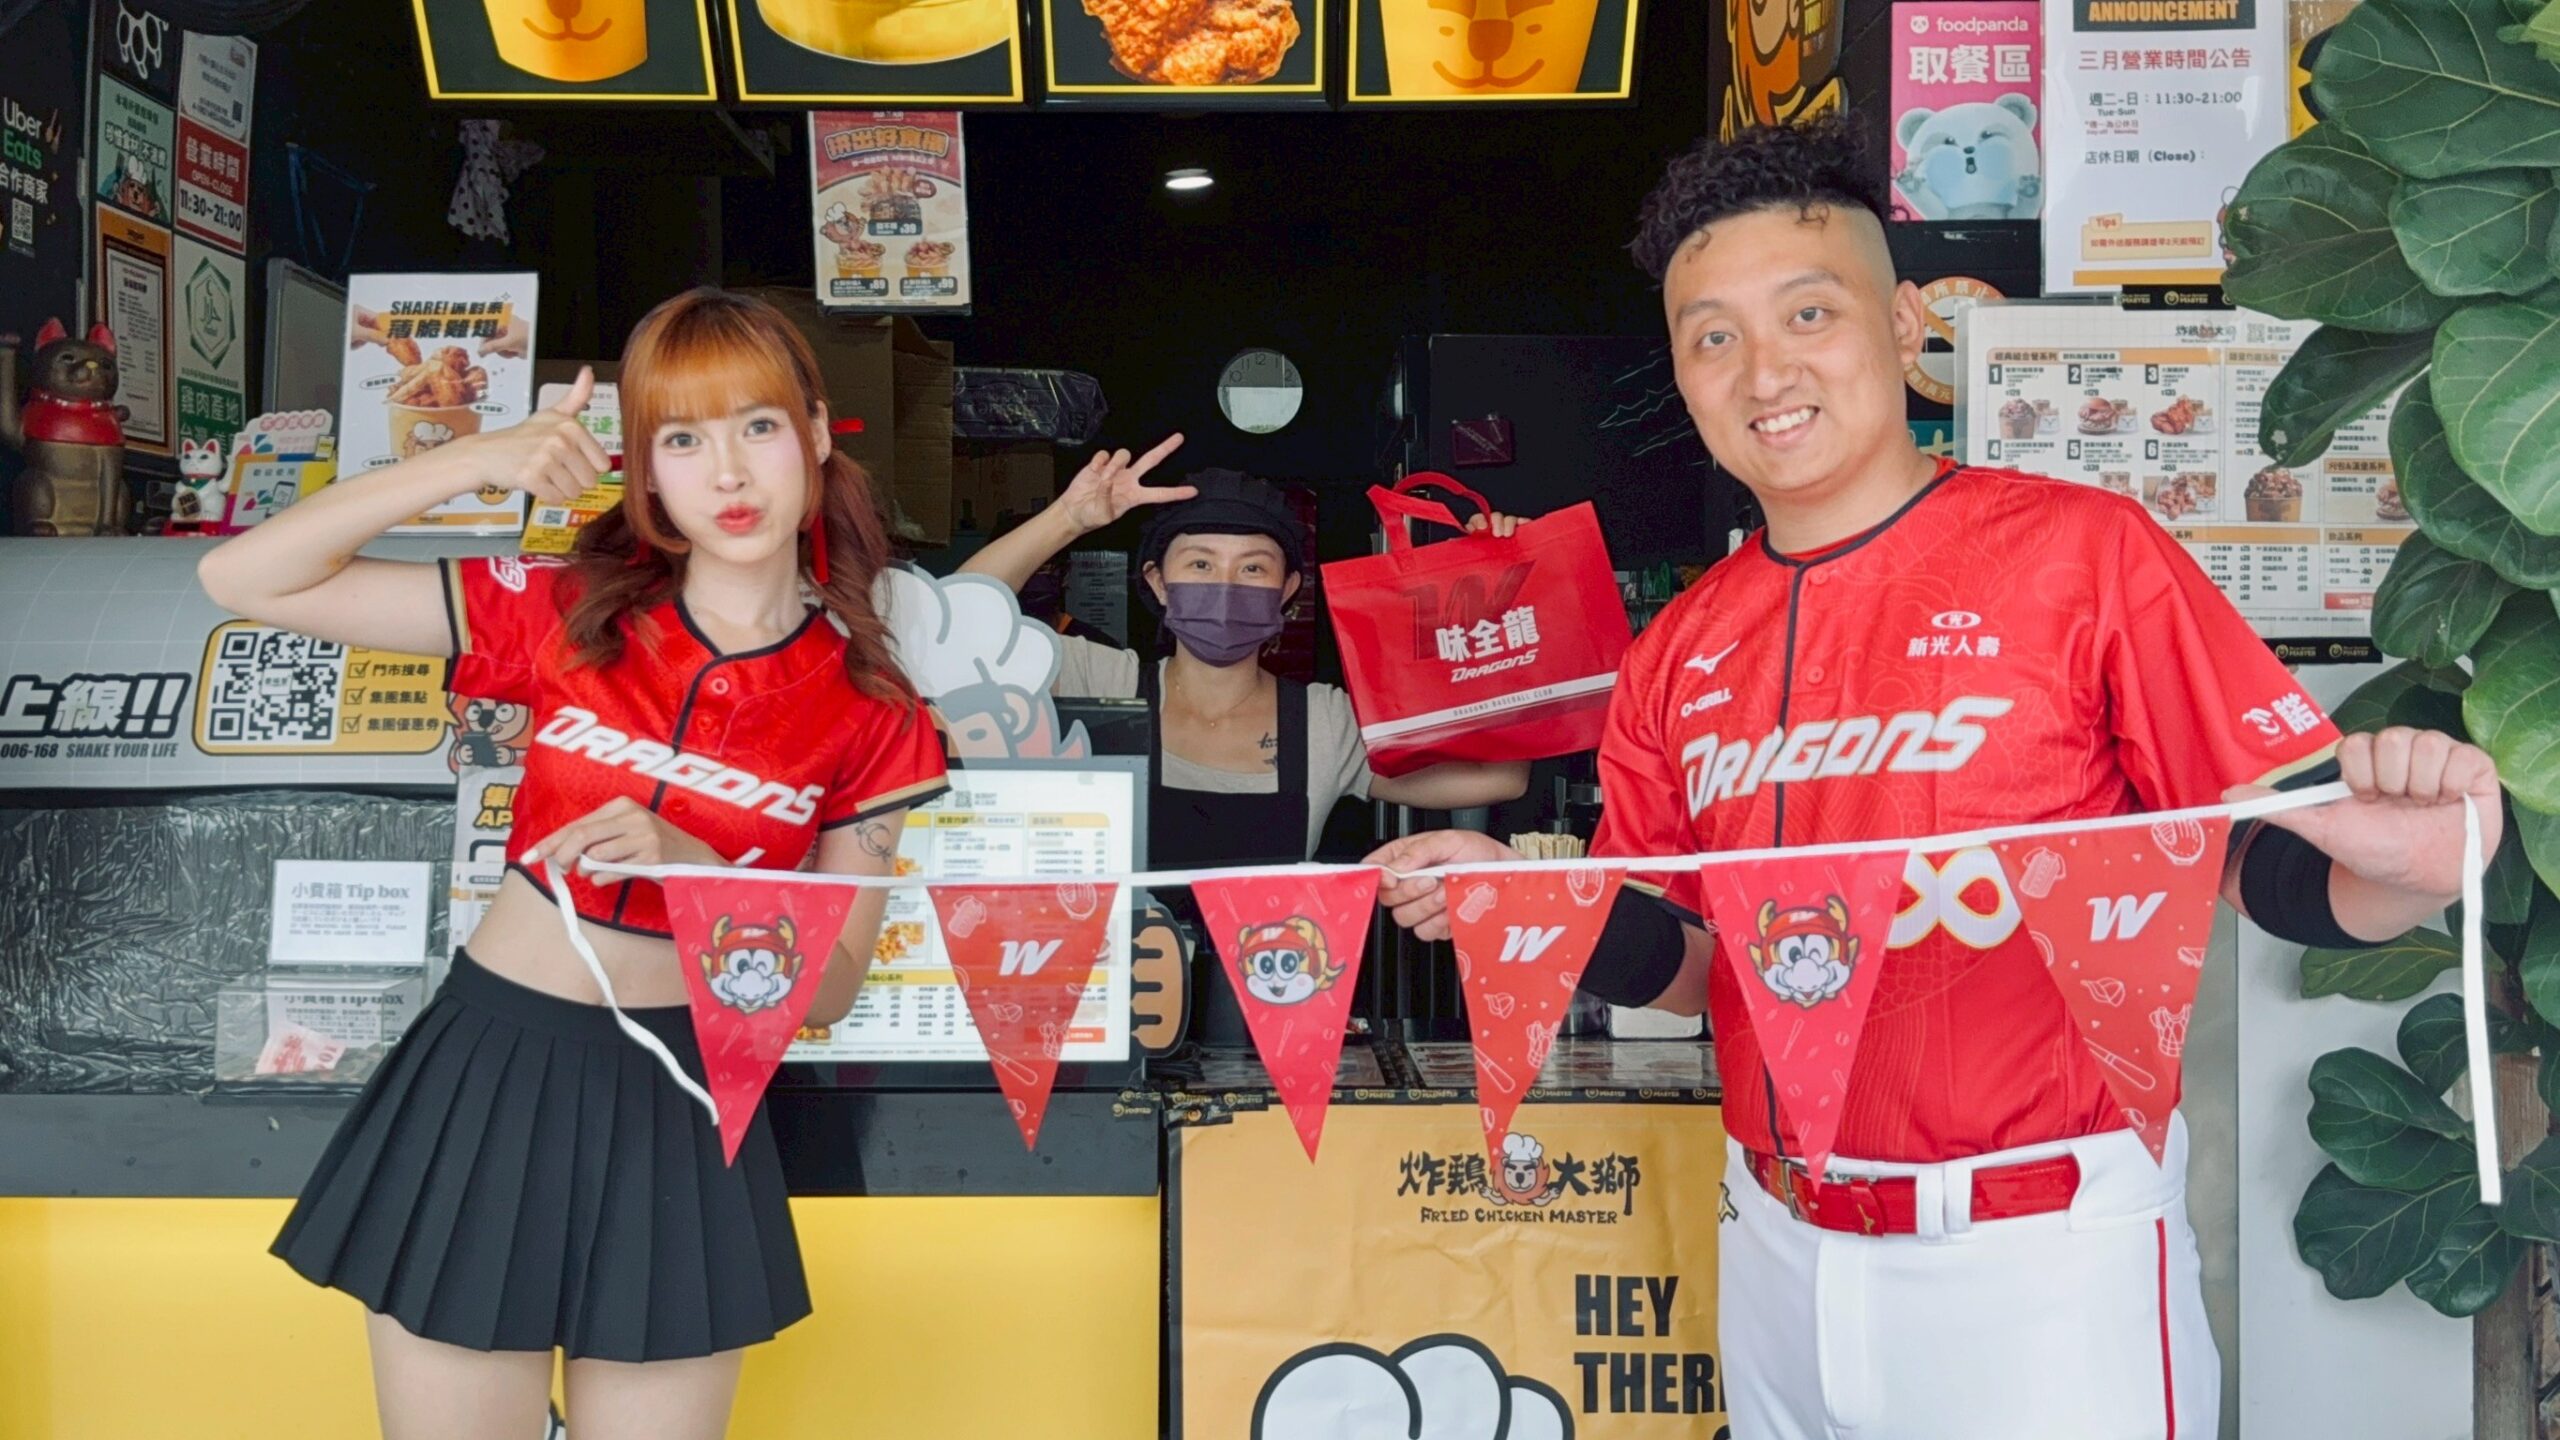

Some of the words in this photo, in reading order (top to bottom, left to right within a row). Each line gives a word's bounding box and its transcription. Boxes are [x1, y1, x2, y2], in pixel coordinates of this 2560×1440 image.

[1937, 17, 2028, 35] foodpanda
[2088, 0, 2239, 21] ANNOUNCEMENT
[1908, 44, 2031, 84] 取餐區
[2078, 48, 2252, 71] 三月營業時間公告
[4, 97, 42, 139] Uber
[2097, 108, 2136, 117] Tue-Sun
[4, 128, 42, 170] Eats
[185, 136, 241, 182] 營業時間
[0, 162, 48, 204] 合作商家
[2096, 217, 2116, 229] Tips
[390, 300, 449, 315] SHARE!
[1436, 605, 1540, 662] 味全龍
[1906, 635, 2000, 657] 新光人壽
[373, 664, 430, 677] 門市搜尋
[0, 676, 188, 735] 上線!!
[1492, 694, 1531, 709] BASEBALL
[1680, 688, 1733, 718] O-GRILL
[66, 743, 110, 758] SHAKE
[113, 743, 149, 758] YOUR
[152, 743, 179, 757] LIFE
[534, 706, 826, 826] DRAGONS
[291, 882, 342, 899] 小費箱
[346, 883, 374, 900] Tip
[378, 884, 410, 899] box
[2088, 892, 2167, 941] W
[999, 939, 1063, 976] W
[1499, 926, 1566, 962] W
[1575, 1274, 1679, 1337] HEY
